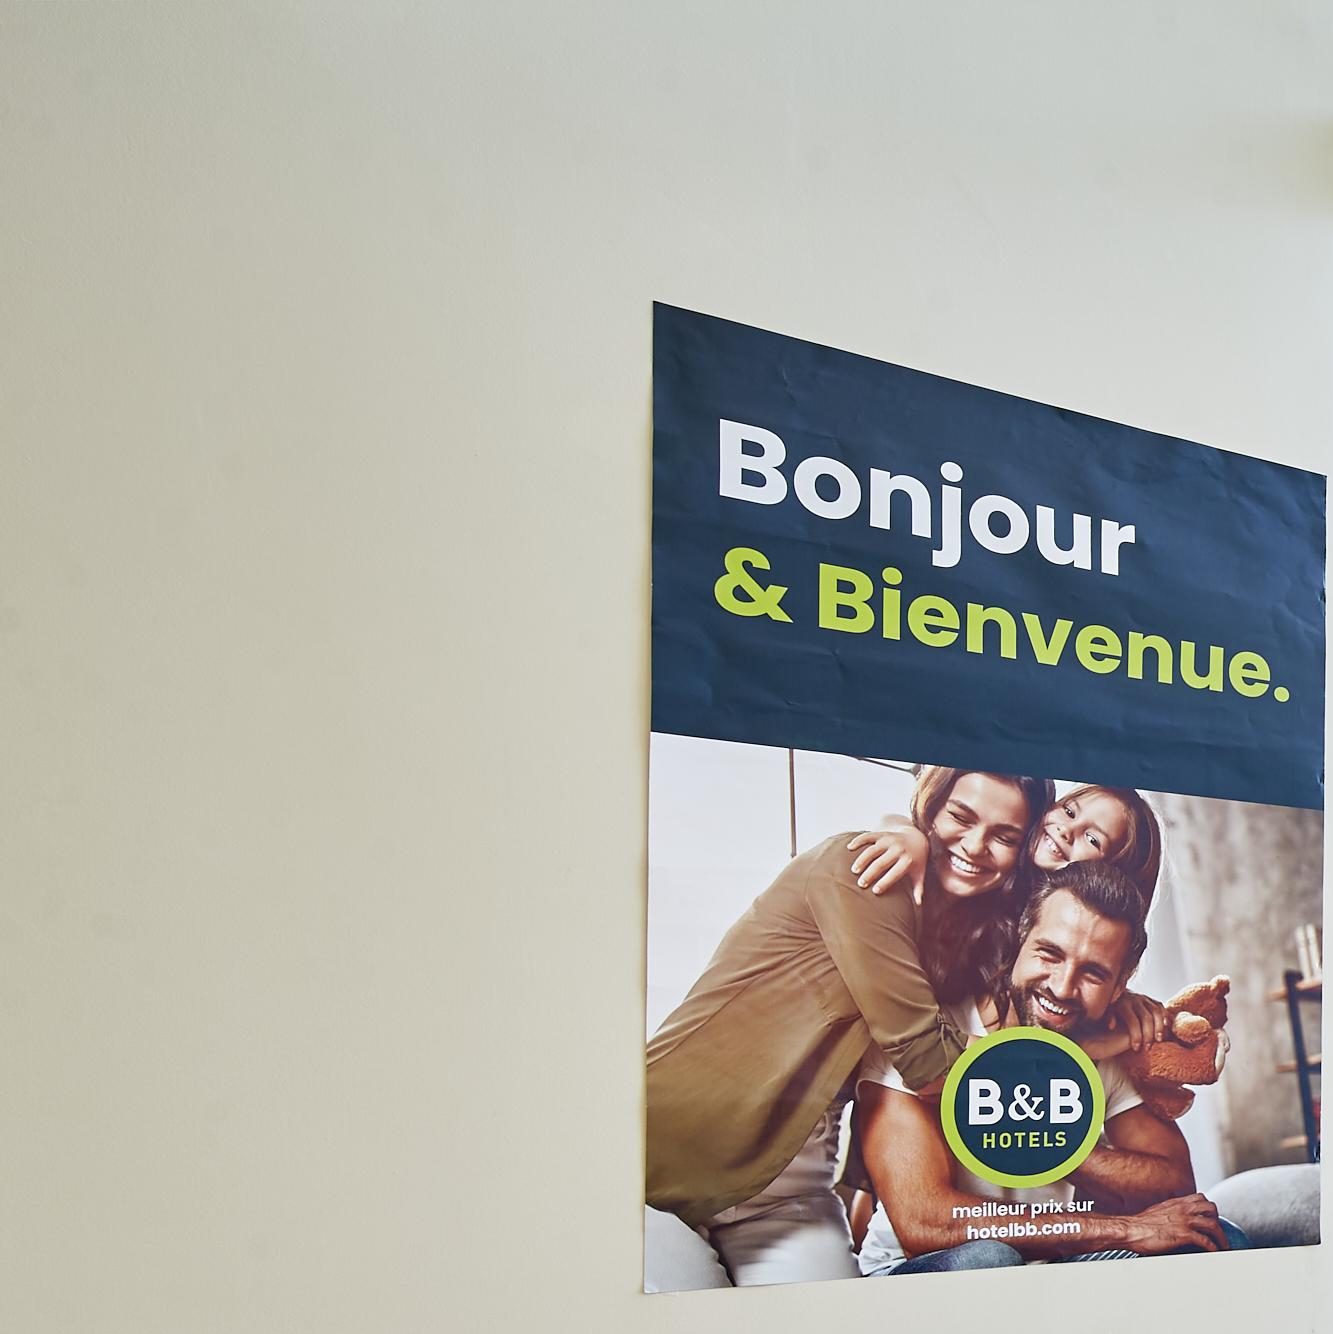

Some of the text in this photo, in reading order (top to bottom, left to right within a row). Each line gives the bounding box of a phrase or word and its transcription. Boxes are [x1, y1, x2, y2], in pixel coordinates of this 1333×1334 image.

[719, 418, 1135, 576] Bonjour
[713, 546, 1290, 703] & Bienvenue.
[968, 1078, 1084, 1125] B&B
[983, 1131, 1067, 1149] HOTELS
[952, 1199, 1095, 1219] meilleur prix sur
[966, 1221, 1081, 1240] hotelbb.com
